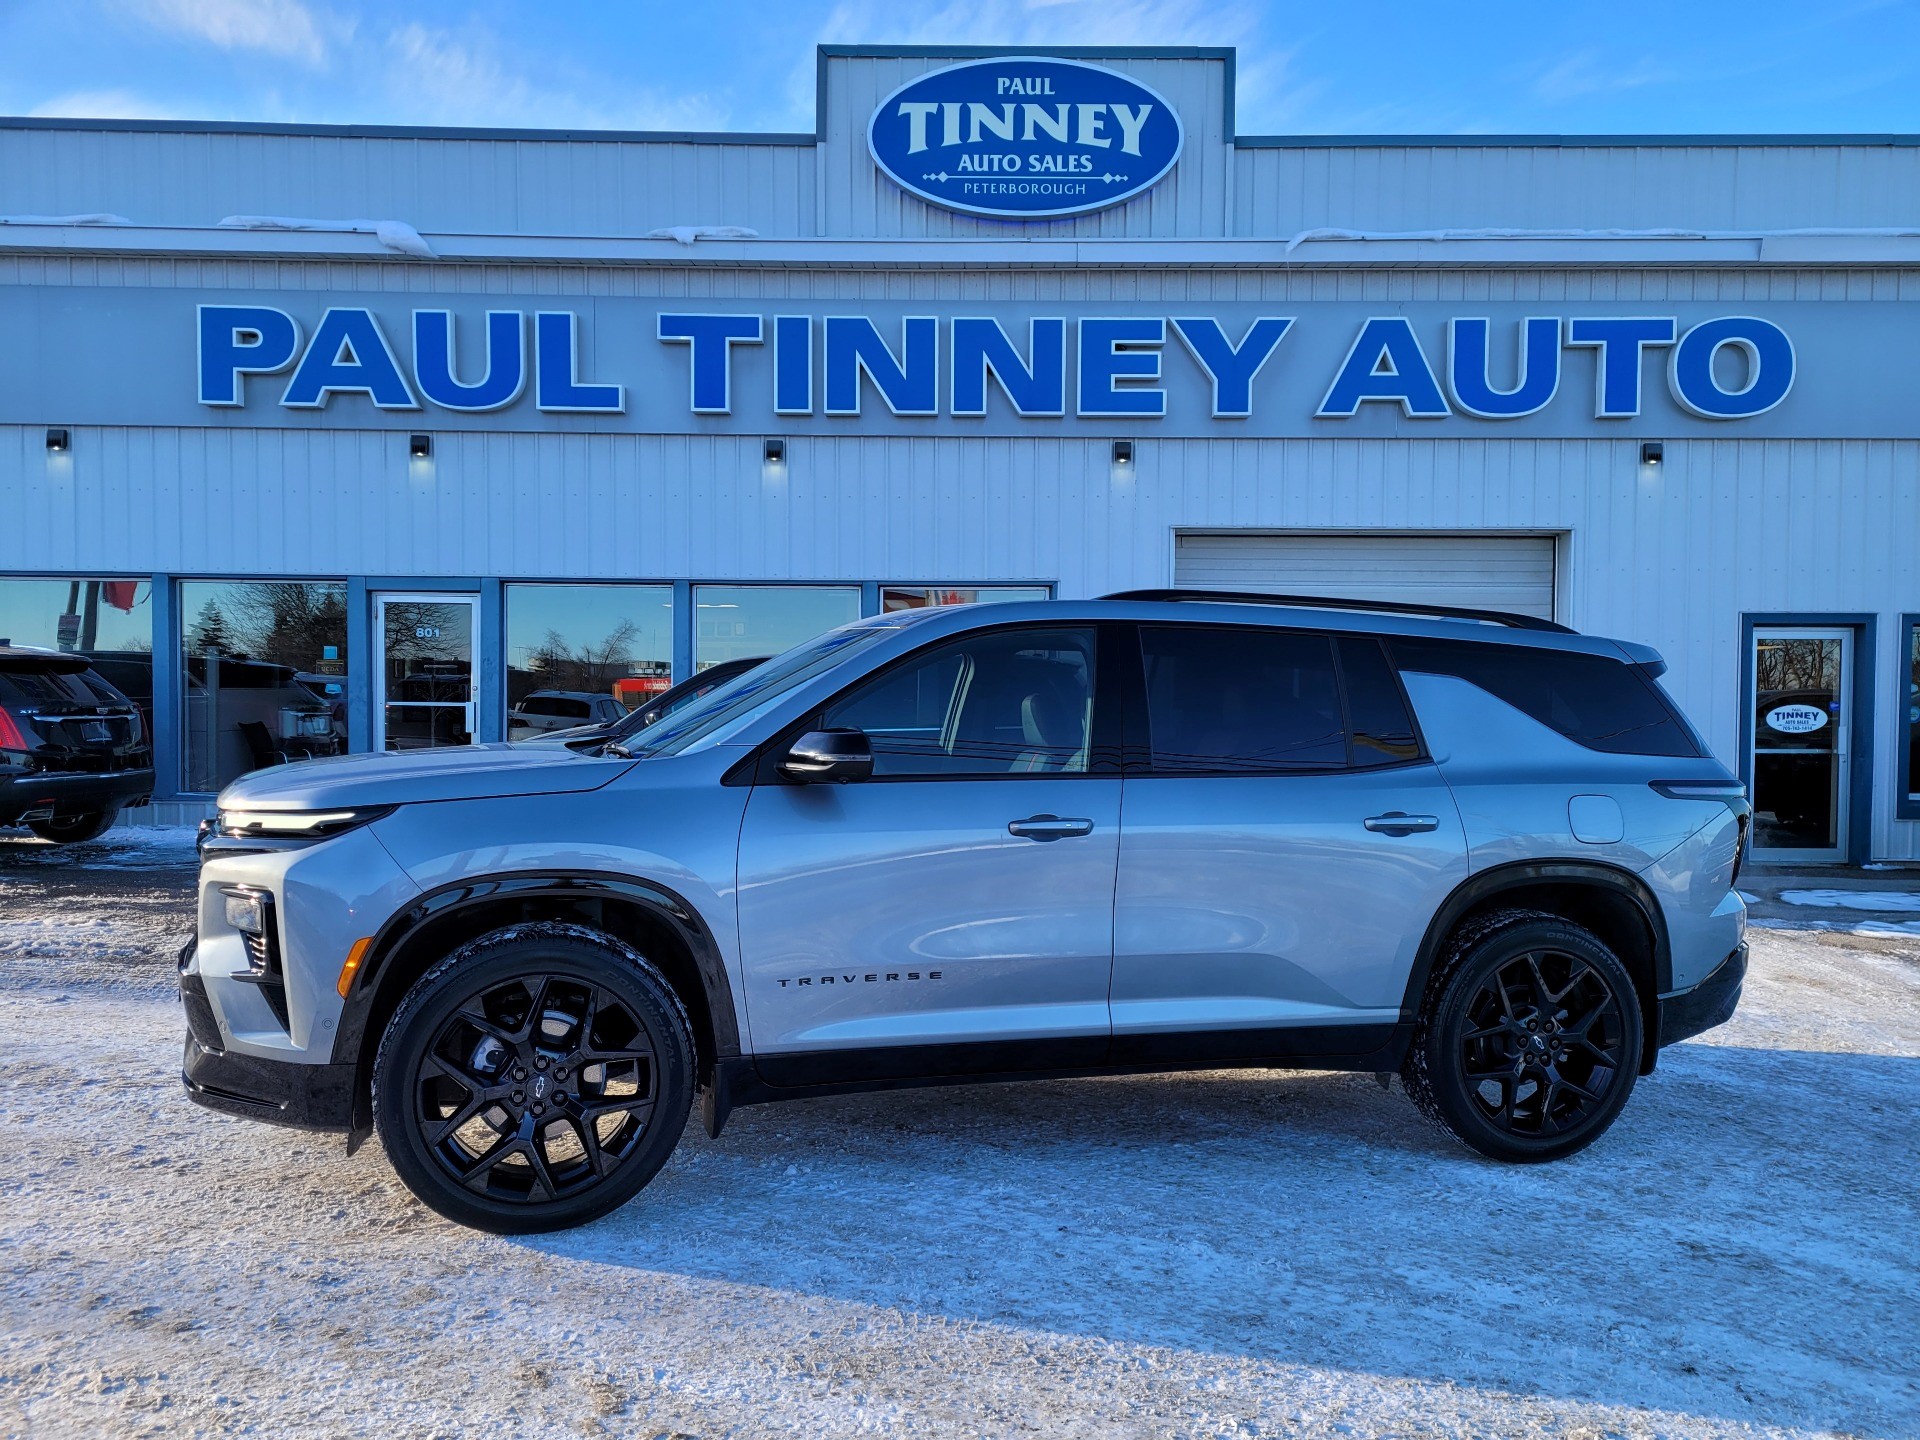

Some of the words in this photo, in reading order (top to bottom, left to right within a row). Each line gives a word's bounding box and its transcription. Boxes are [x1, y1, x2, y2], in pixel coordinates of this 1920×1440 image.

[997, 77, 1055, 95] PAUL
[897, 102, 1154, 157] TINNEY
[957, 154, 1021, 172] AUTO
[1028, 154, 1093, 173] SALES
[964, 183, 1086, 195] PETERBOROUGH
[196, 304, 626, 413] PAUL
[656, 312, 1298, 419] TINNEY
[1313, 315, 1797, 420] AUTO
[415, 627, 440, 638] 801
[1774, 712, 1819, 722] TINNEY
[776, 971, 943, 988] TRAVERSE
[602, 969, 676, 1069] CONTINENTAL
